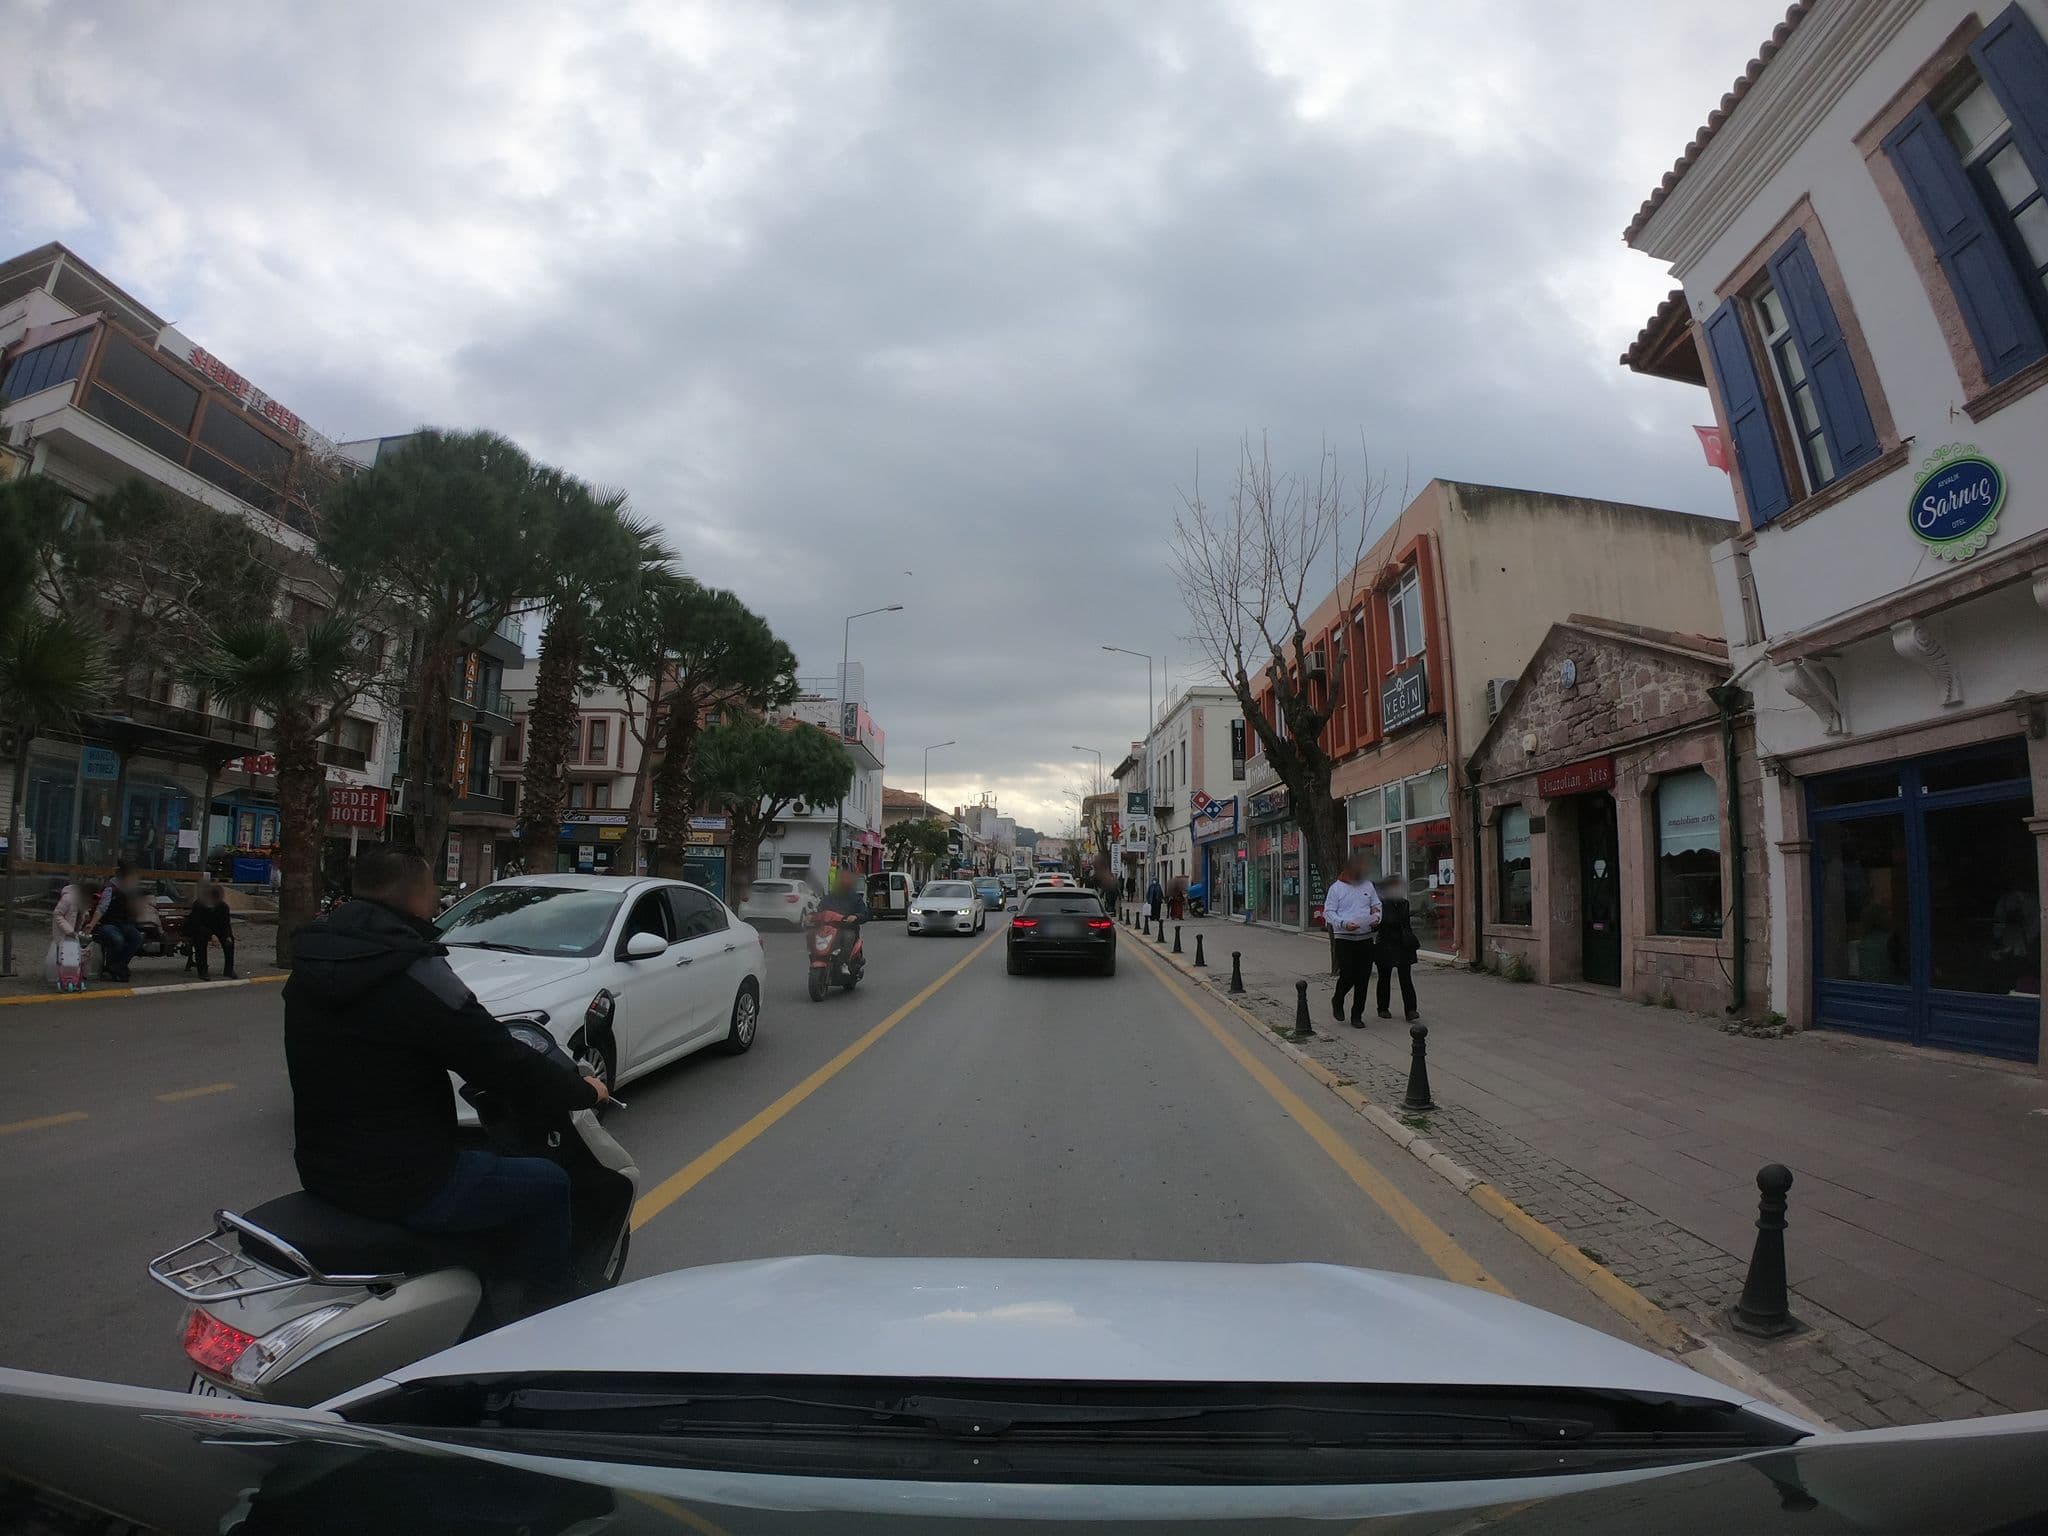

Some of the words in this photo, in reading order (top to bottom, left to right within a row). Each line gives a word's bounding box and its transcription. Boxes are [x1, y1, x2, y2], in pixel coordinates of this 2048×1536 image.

[1918, 478, 1991, 528] Sarnıç
[1951, 518, 1967, 529] OTEL
[1386, 687, 1418, 716] YEĞİN
[331, 790, 379, 807] SEDEF
[331, 806, 377, 824] HOTEL
